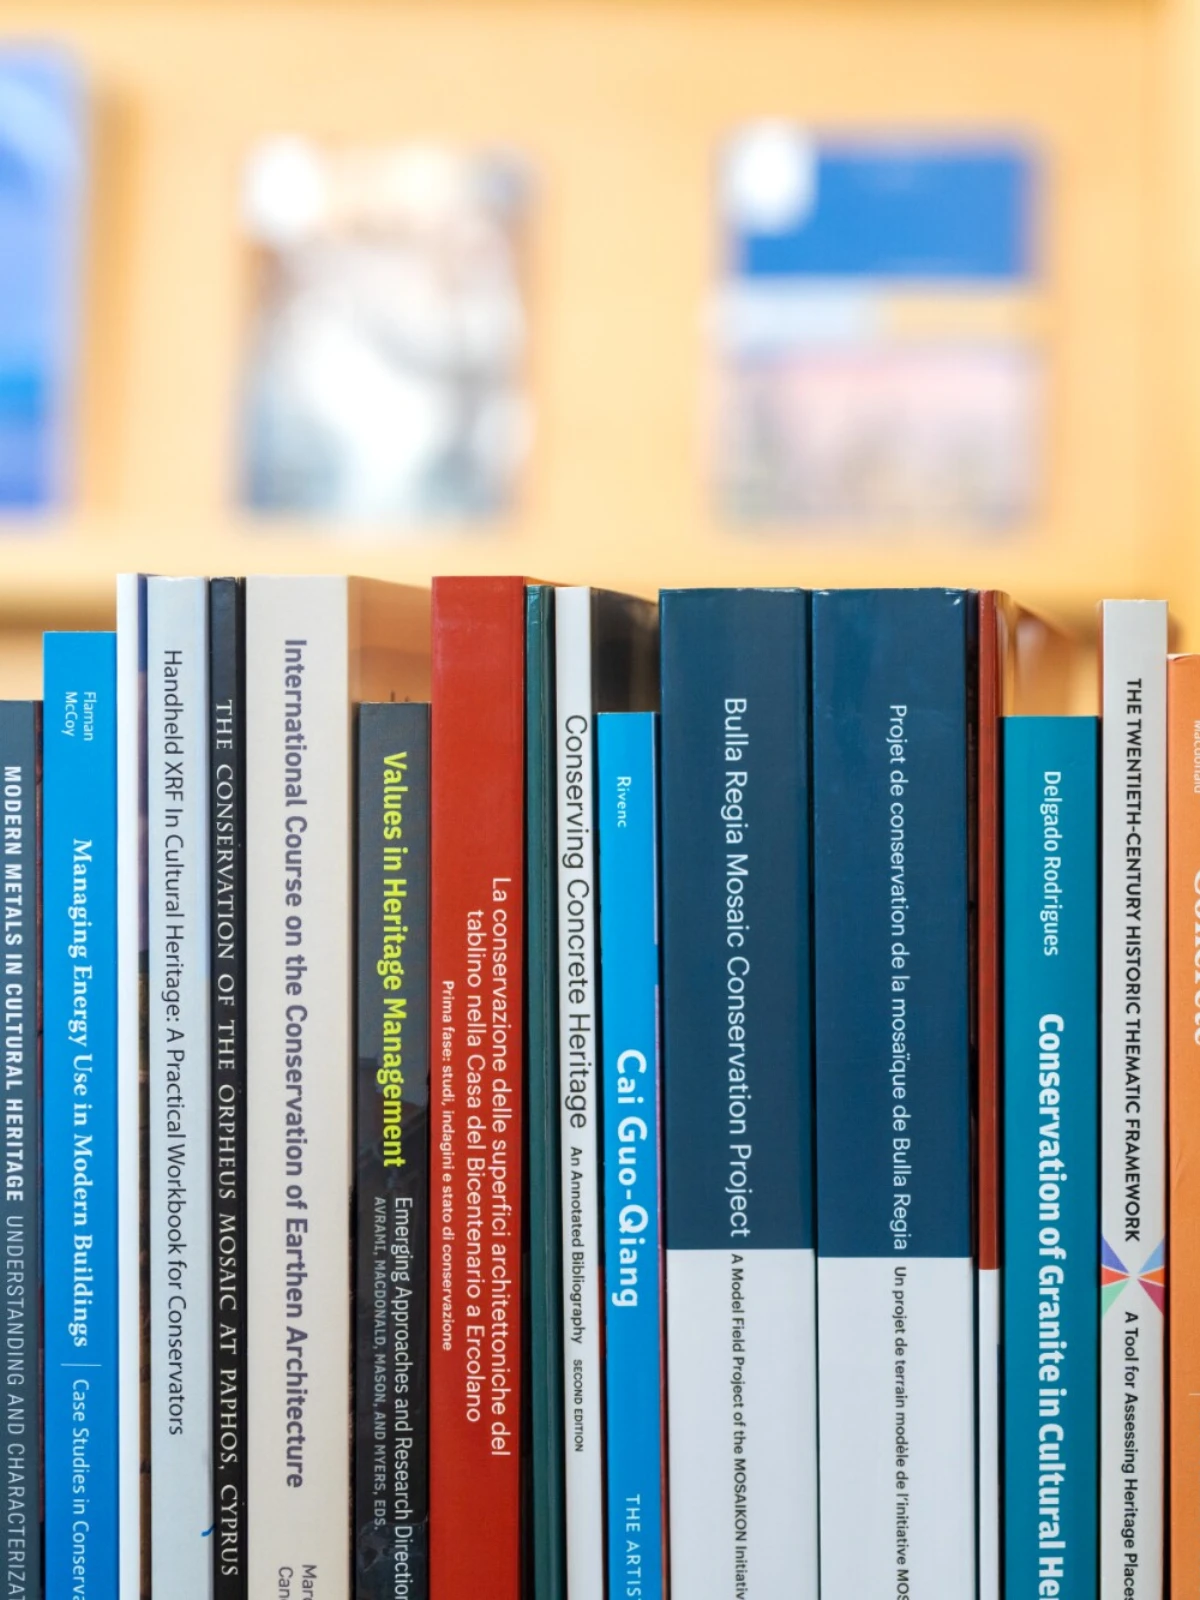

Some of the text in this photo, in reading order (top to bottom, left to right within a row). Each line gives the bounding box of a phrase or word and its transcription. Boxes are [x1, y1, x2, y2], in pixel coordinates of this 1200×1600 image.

[60, 691, 79, 737] McCoy
[83, 691, 97, 742] Flaman
[561, 714, 593, 1129] Conserving Concrete Heritage
[616, 775, 632, 828] Rivenc
[1039, 771, 1063, 957] Delgado Rodrigues
[4, 766, 24, 1201] MODERN METALS IN CULTURAL HERITAGE
[67, 838, 94, 1348] Managing Energy Use in Modern Buildings
[160, 650, 188, 1436] Handheld XRF In Cultural Heritage: A Practical Workbook for Conservators
[284, 639, 309, 1489] International Course on the Conservation of Earthen Architecture
[376, 751, 409, 1168] Values in Heritage Management
[487, 877, 513, 1456] La conservazione delle superfici architettoniche del
[720, 698, 753, 1238] Bulla Regia Mosaic Conservation Project
[1124, 677, 1142, 1242] THE TWENTIETH-CENTURY HISTORIC THEMATIC FRAMEWORK
[372, 1196, 387, 1531] AVRAMI, MACDONALD, MASON, AND MYERS, EDS.
[569, 1146, 586, 1344] An Annotated Bibliography
[611, 1048, 649, 1307] Cai Guo-Qiang
[572, 1359, 584, 1453] SECOND EDITION
